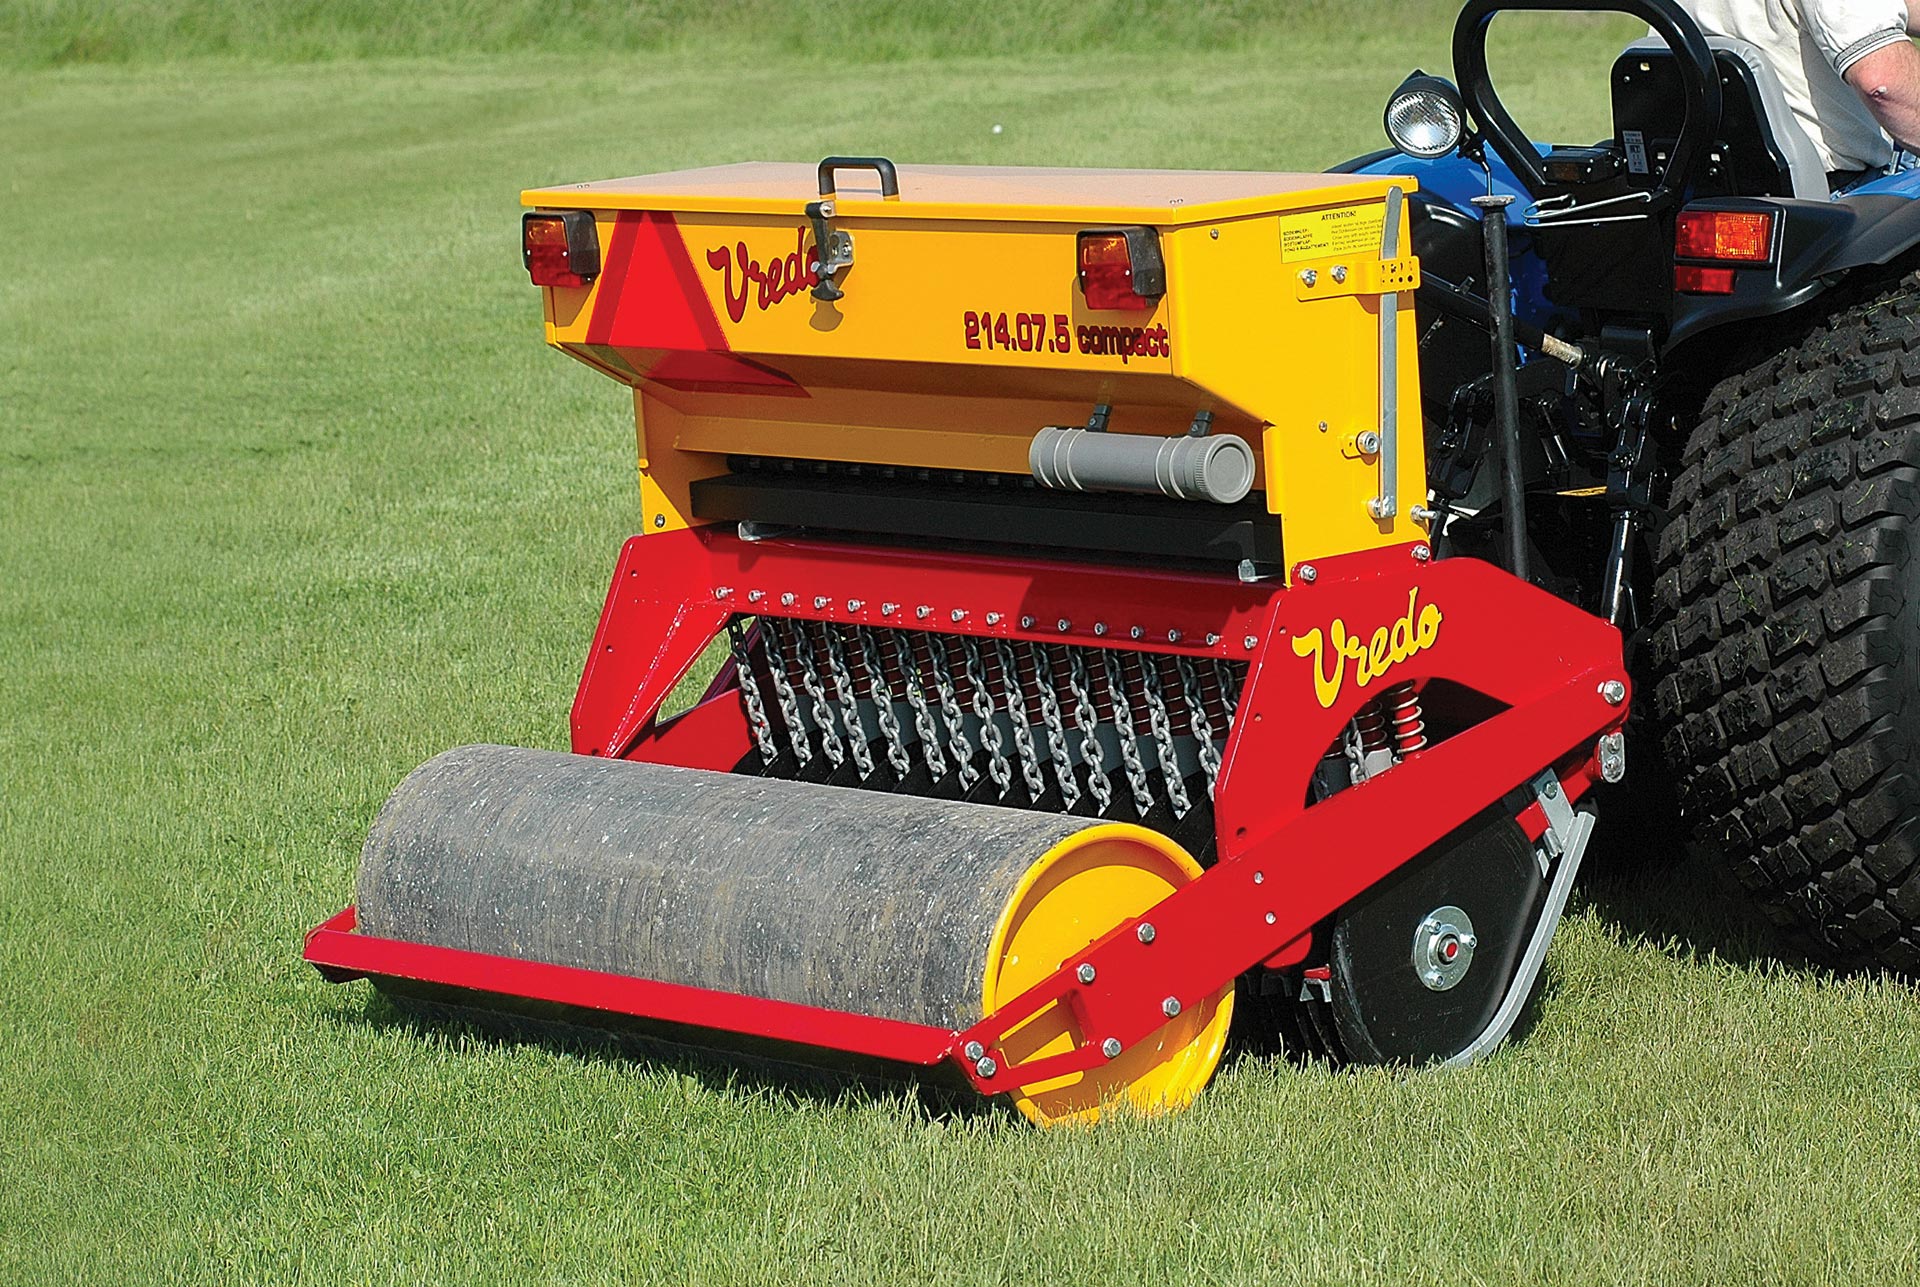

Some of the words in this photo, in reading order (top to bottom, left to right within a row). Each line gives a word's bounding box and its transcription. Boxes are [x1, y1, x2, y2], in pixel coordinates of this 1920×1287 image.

[964, 311, 1071, 353] 214.07.5
[1077, 323, 1170, 364] compact
[1291, 586, 1443, 709] Vredo
